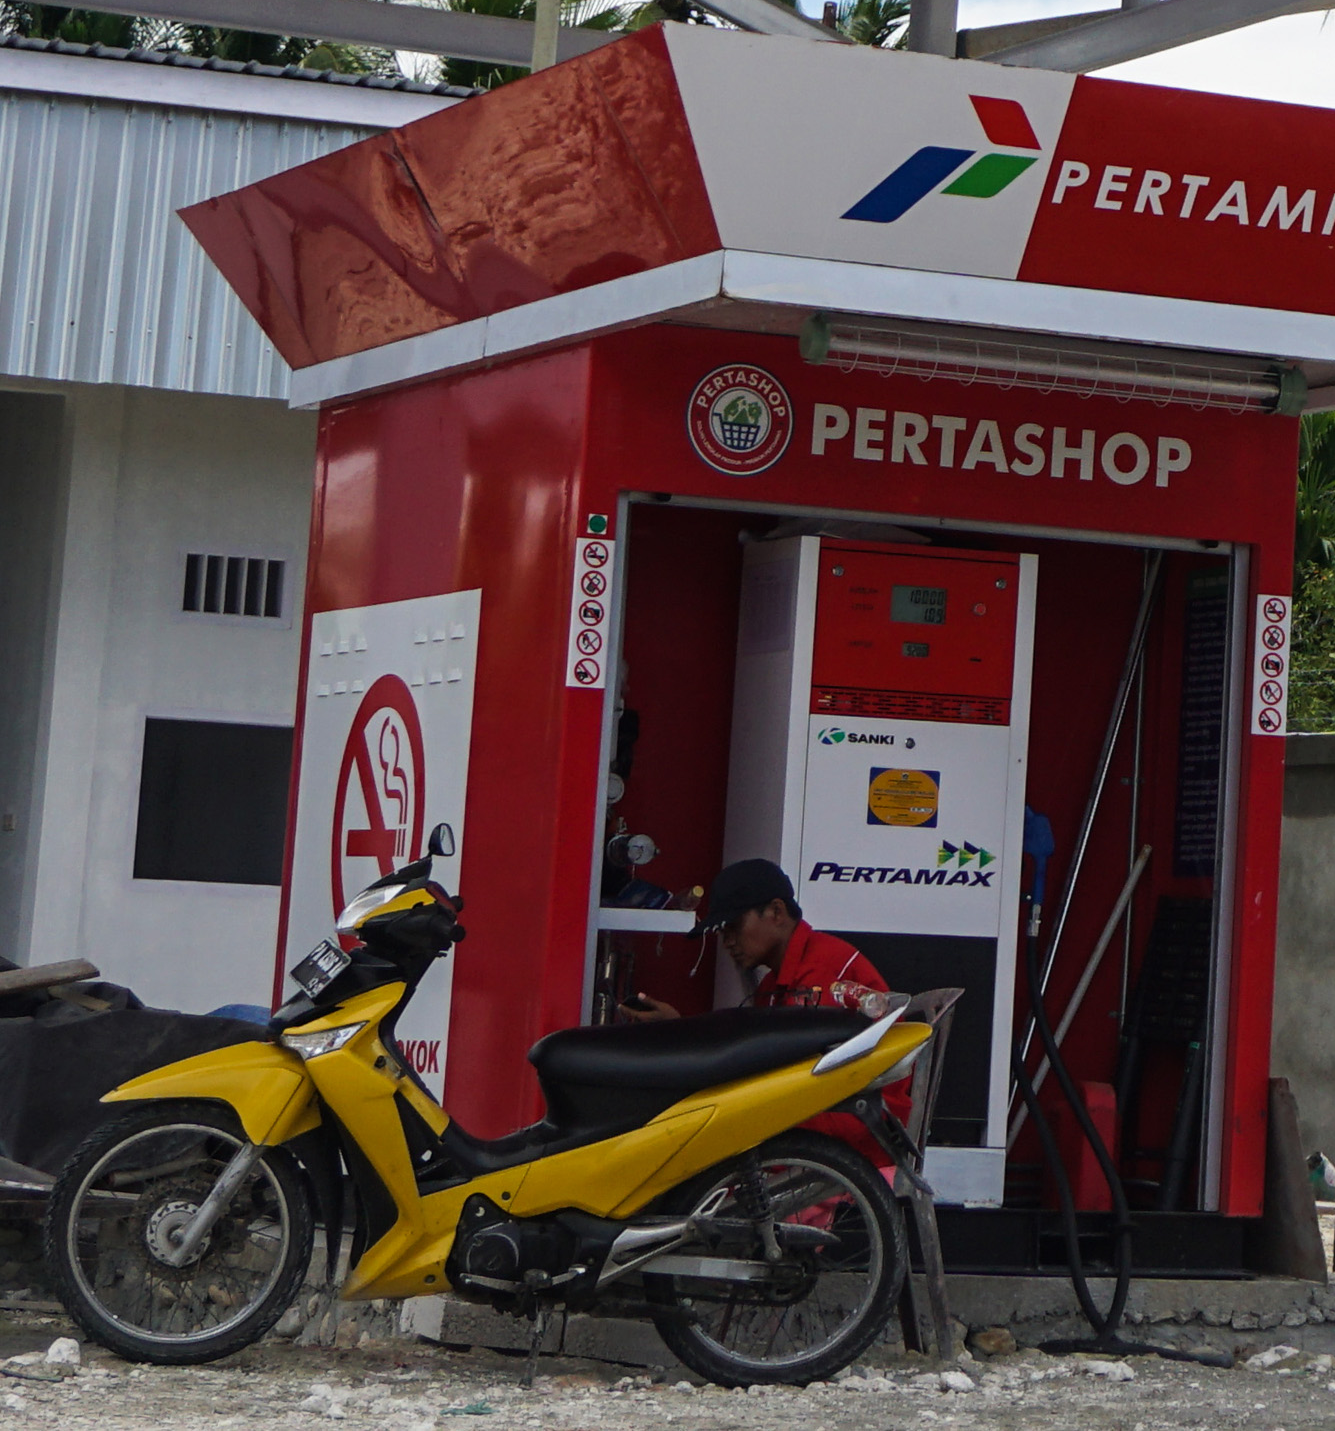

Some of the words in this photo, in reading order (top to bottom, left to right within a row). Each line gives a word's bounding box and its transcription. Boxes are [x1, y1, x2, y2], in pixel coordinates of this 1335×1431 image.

[696, 370, 787, 418] PERTASHOP
[810, 402, 1194, 488] PERTASHOP
[847, 732, 895, 746] SANKI
[808, 861, 997, 888] PERTAMAX
[396, 1039, 442, 1074] KOK
